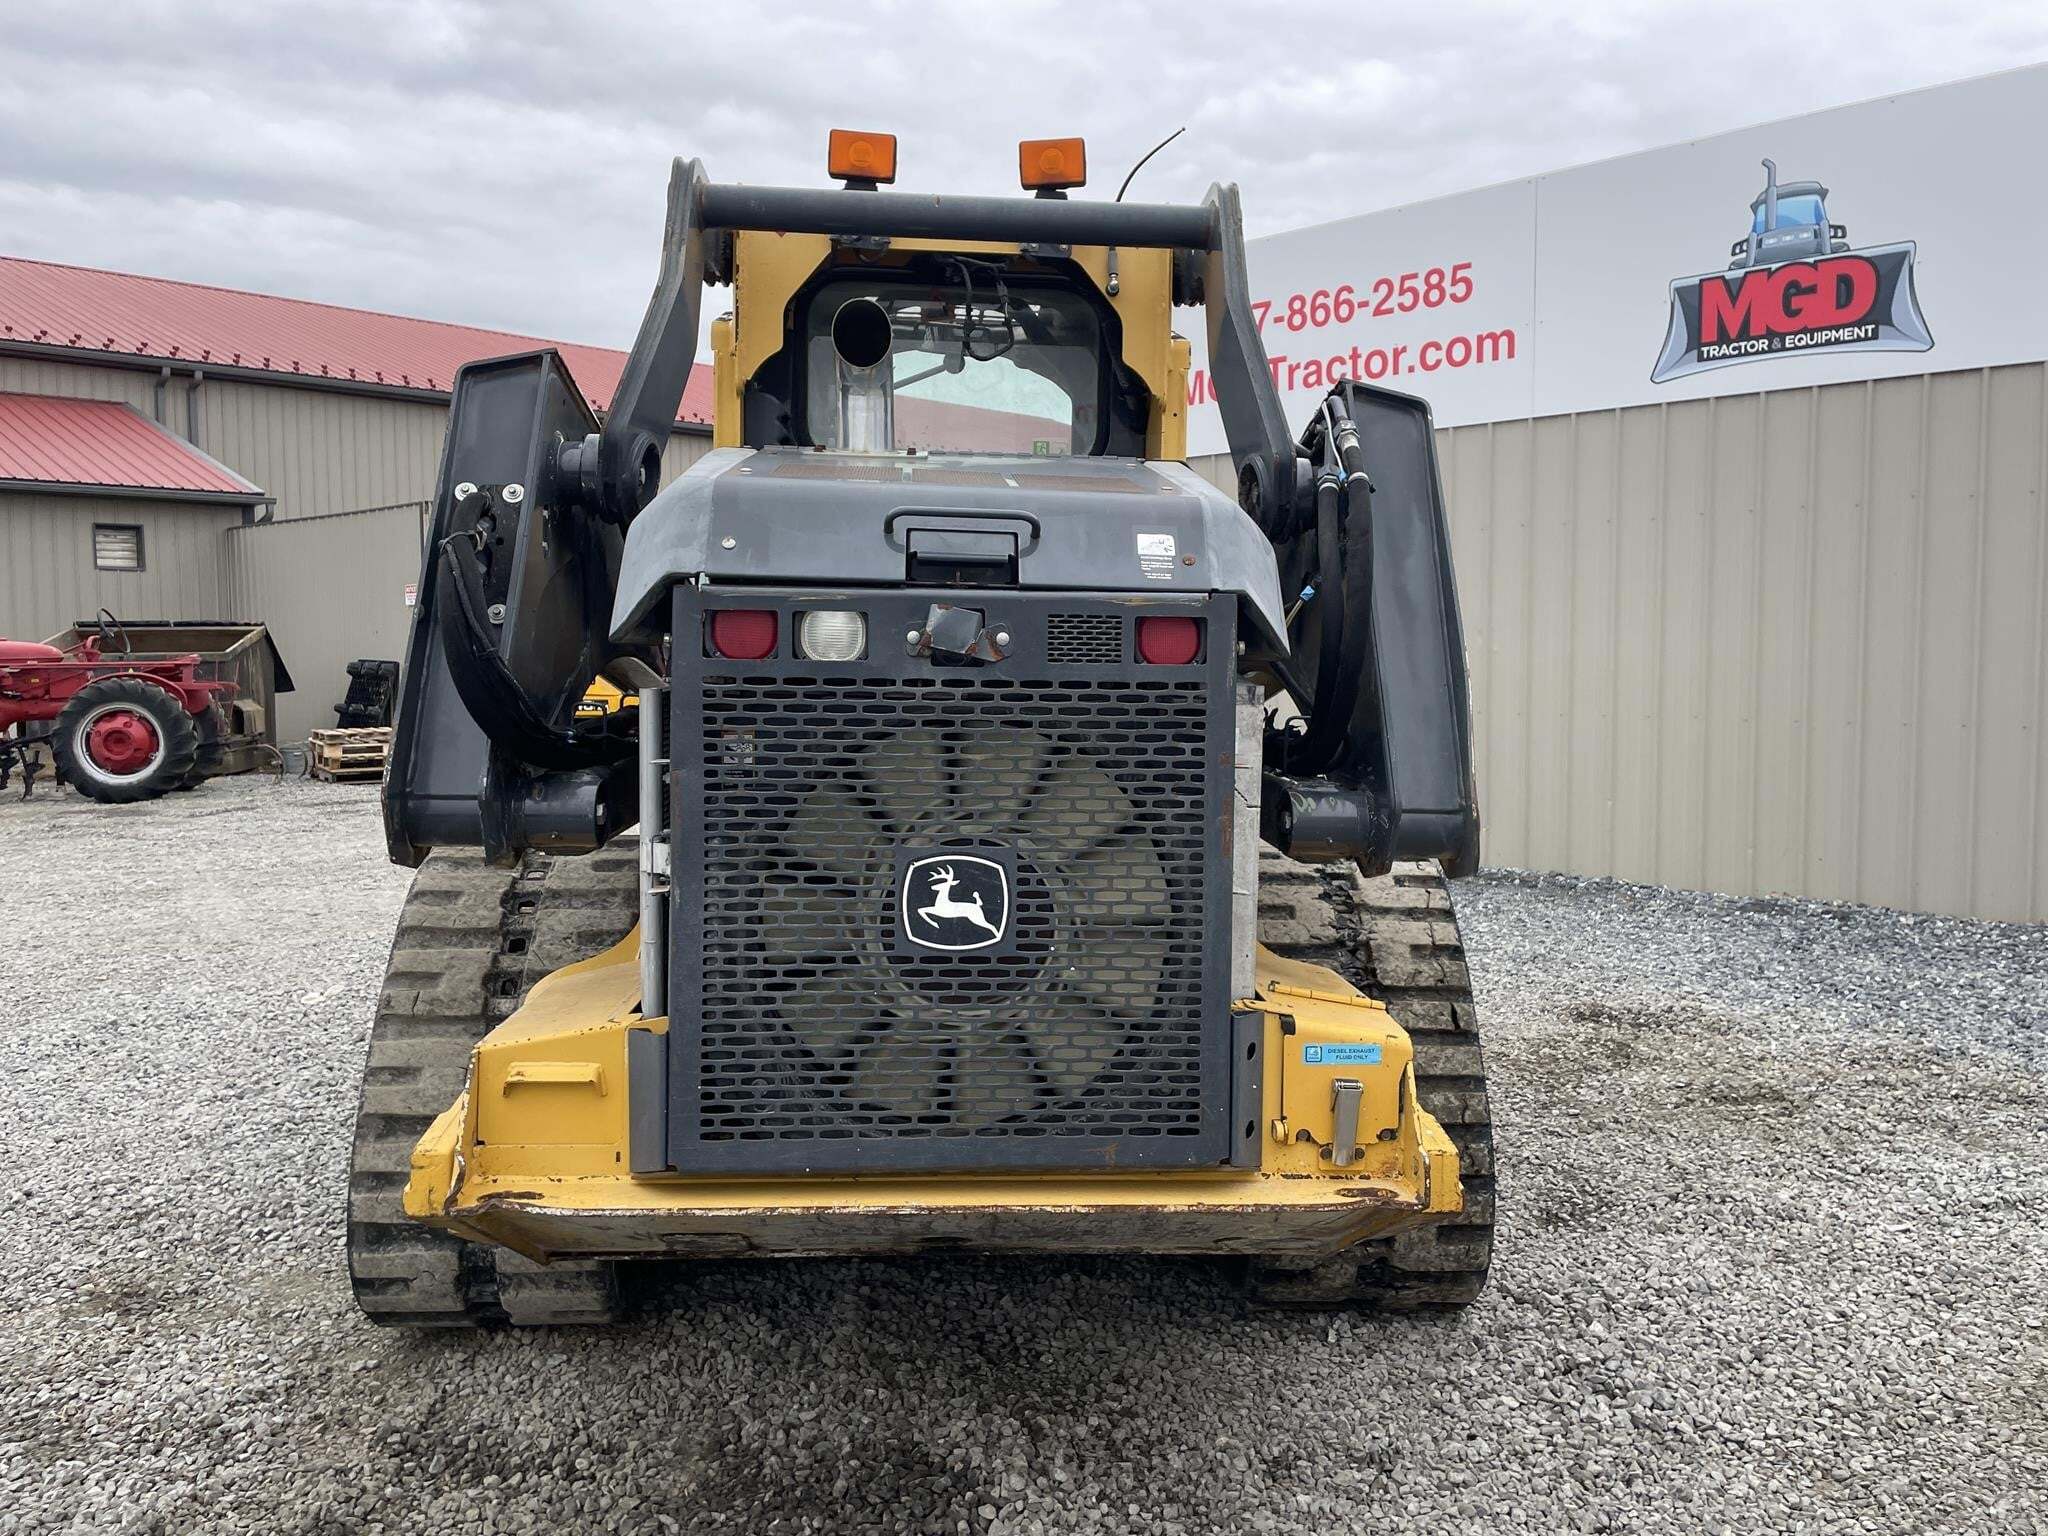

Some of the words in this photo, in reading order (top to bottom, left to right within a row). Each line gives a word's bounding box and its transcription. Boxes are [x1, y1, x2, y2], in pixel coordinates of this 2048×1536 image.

[1252, 262, 1474, 335] 7-866-2585
[1700, 257, 1878, 343] MGD
[1186, 328, 1516, 406] MTractor.com
[1701, 338, 1769, 359] TRACTOR
[1771, 337, 1782, 350] &
[1785, 324, 1876, 349] EQUIPMENT
